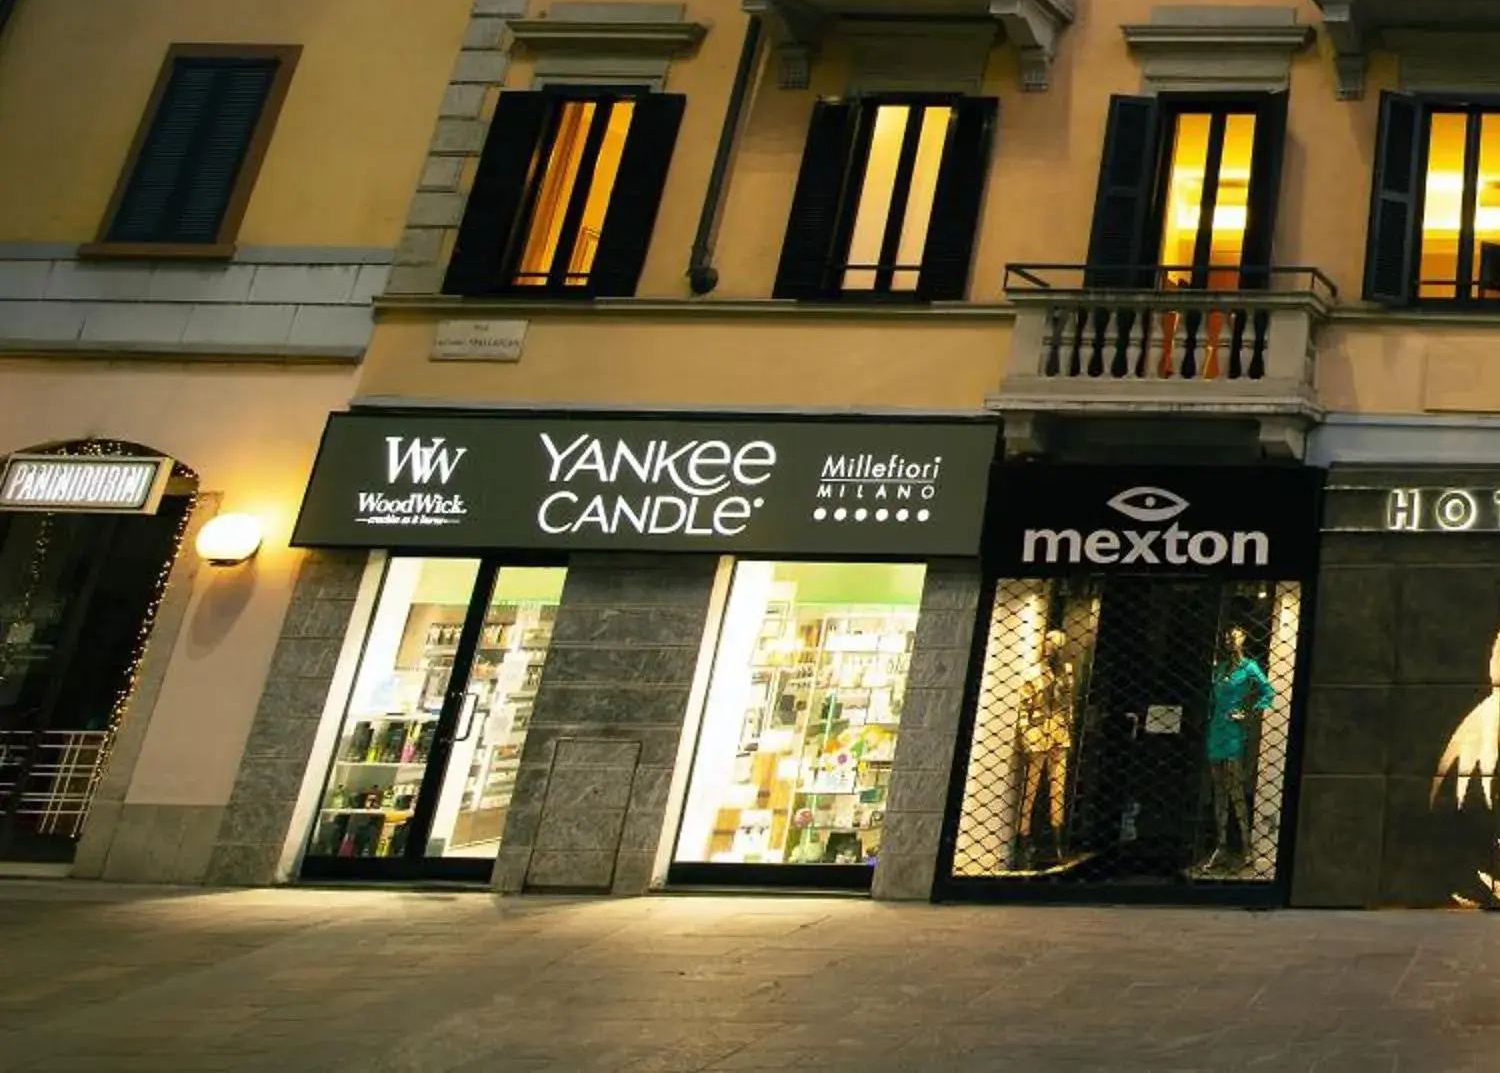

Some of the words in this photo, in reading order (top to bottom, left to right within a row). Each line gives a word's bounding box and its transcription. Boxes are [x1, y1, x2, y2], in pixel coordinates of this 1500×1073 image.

[821, 454, 942, 479] Millefiori
[816, 484, 935, 500] MILANO
[1021, 522, 1270, 565] mexton
